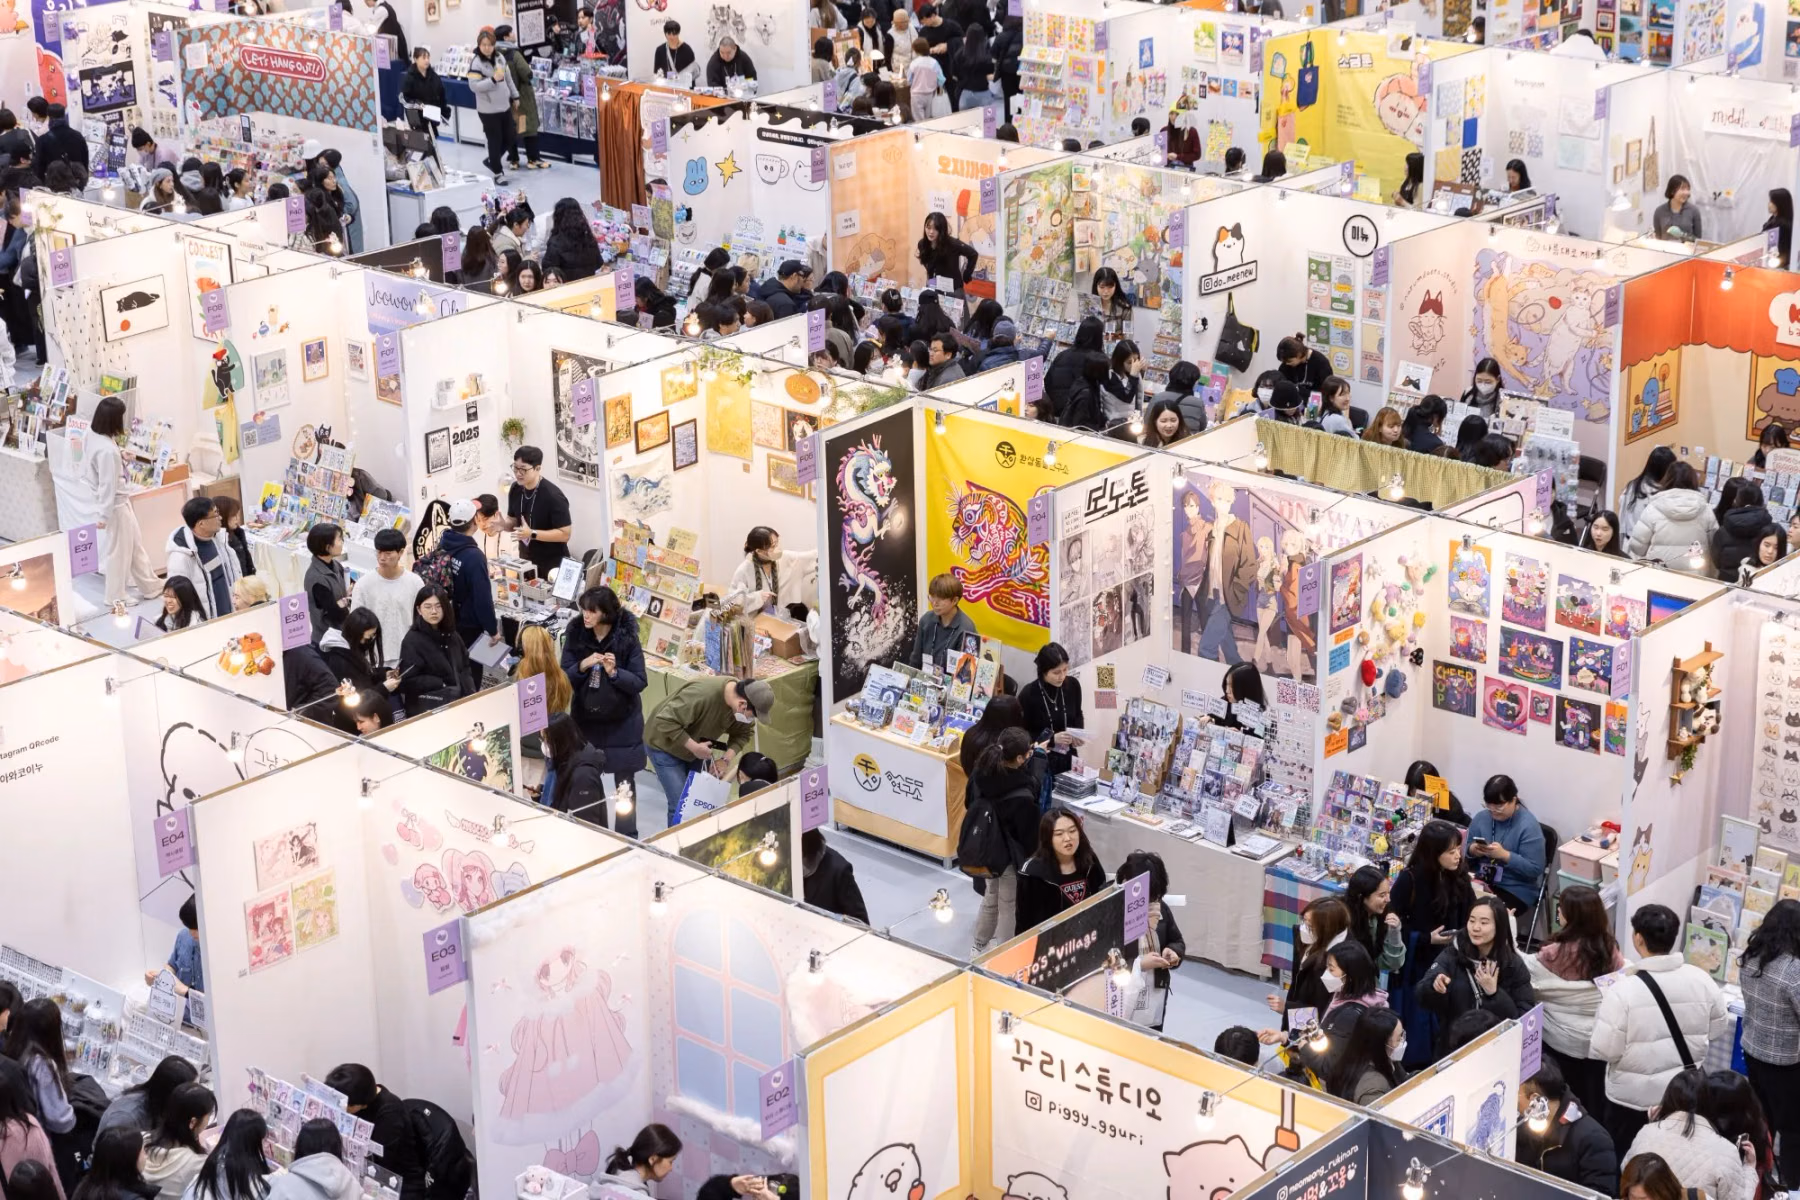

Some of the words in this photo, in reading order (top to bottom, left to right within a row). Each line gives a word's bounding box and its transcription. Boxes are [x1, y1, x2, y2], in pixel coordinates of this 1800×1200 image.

[270, 56, 296, 71] HANG
[188, 241, 224, 261] COOLEST
[618, 283, 632, 291] F38
[207, 304, 223, 313] F08
[810, 325, 822, 333] F37
[381, 348, 395, 357] F07
[577, 397, 592, 406] F06
[1537, 487, 1549, 497] F34
[1031, 512, 1045, 522] F04
[74, 542, 93, 554] E37
[1302, 582, 1317, 593] F03
[285, 612, 305, 624] E36
[1616, 662, 1628, 672] F01
[1436, 665, 1474, 689] CHEER
[523, 695, 543, 708] E35
[28, 735, 60, 750] QRcode
[804, 788, 824, 803] E34
[693, 798, 718, 811] EPSO
[161, 831, 185, 848] E04
[1064, 881, 1084, 893] GUESS
[1127, 897, 1146, 913] E33
[1056, 929, 1098, 961] Village
[431, 945, 457, 962] E03
[1522, 1032, 1539, 1050] E32
[765, 1087, 790, 1107] E02
[1049, 1101, 1143, 1146] piggy_gguri
